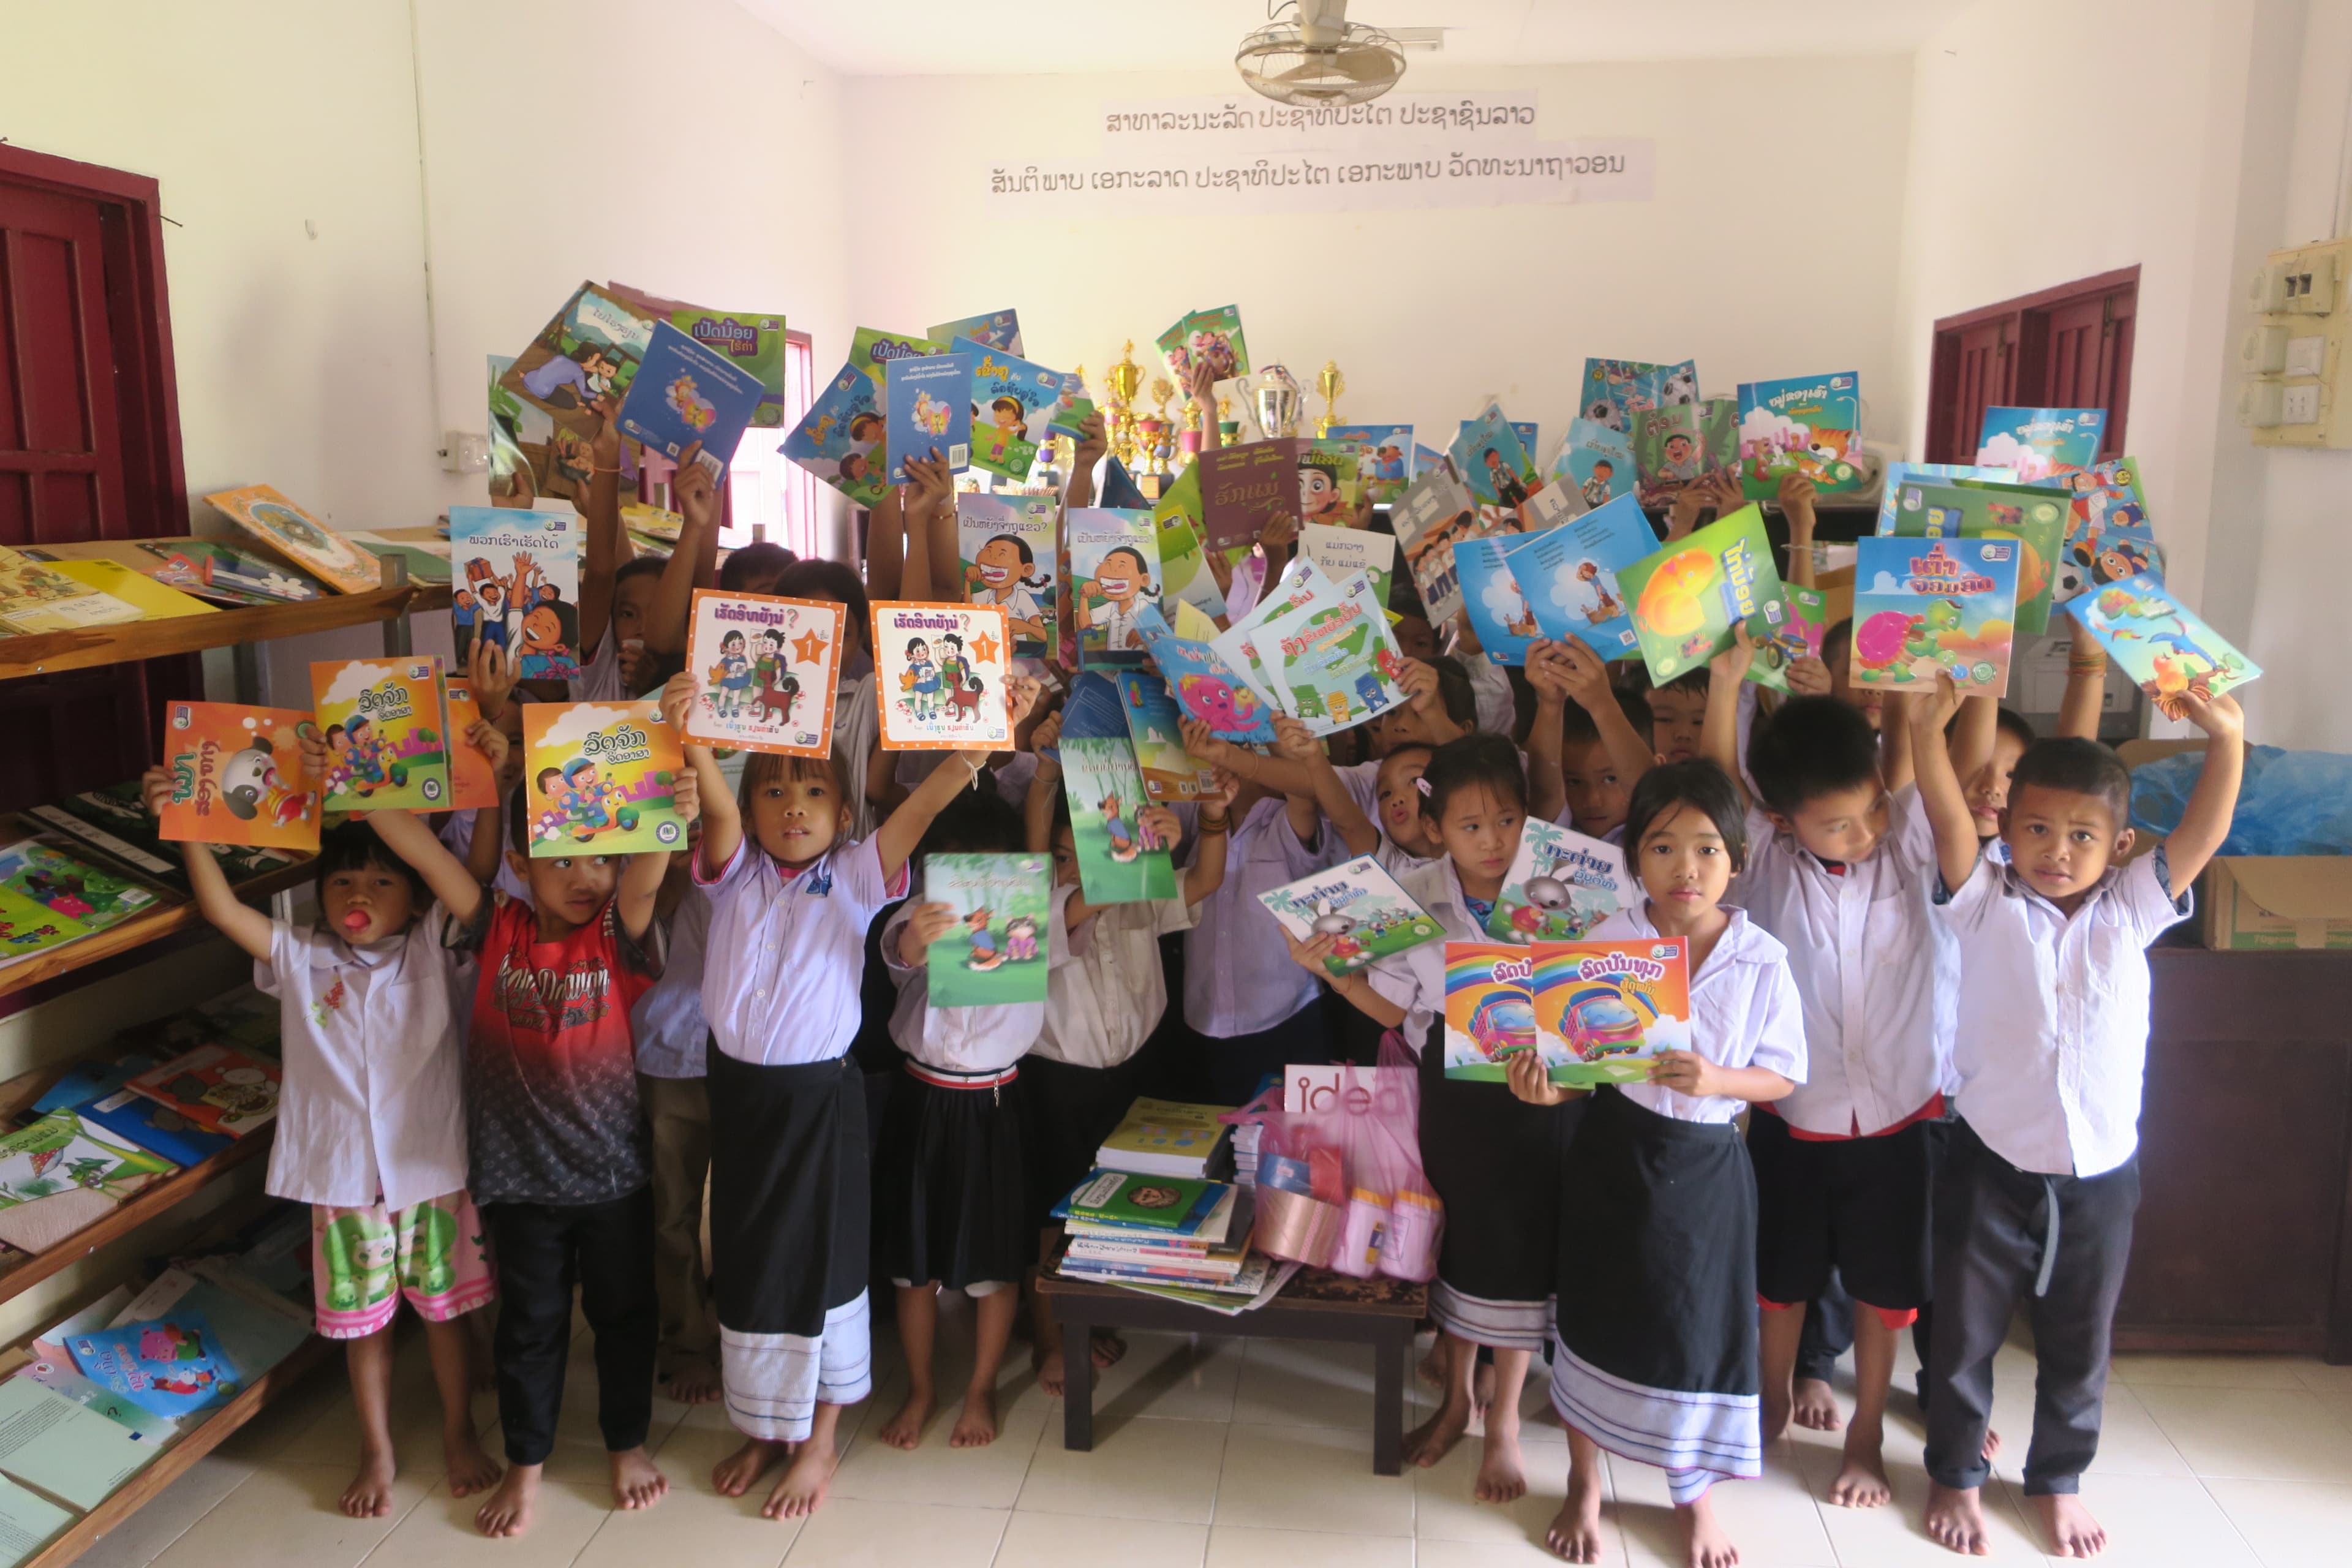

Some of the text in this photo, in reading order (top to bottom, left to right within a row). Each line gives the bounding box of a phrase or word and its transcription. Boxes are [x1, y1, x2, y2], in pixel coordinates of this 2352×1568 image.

[1106, 99, 1535, 132] ສາທາລະນະລັດ ປະຊາທິປະໄຕ ປະຊາຊົນລາວ
[1091, 168, 1188, 190] ເອກະລາດ
[1196, 159, 1330, 192] ປະຊາທິປະໄຕ
[1338, 160, 1441, 183] ເອກະພາບ
[805, 639, 812, 657] 1
[981, 641, 987, 657] 1
